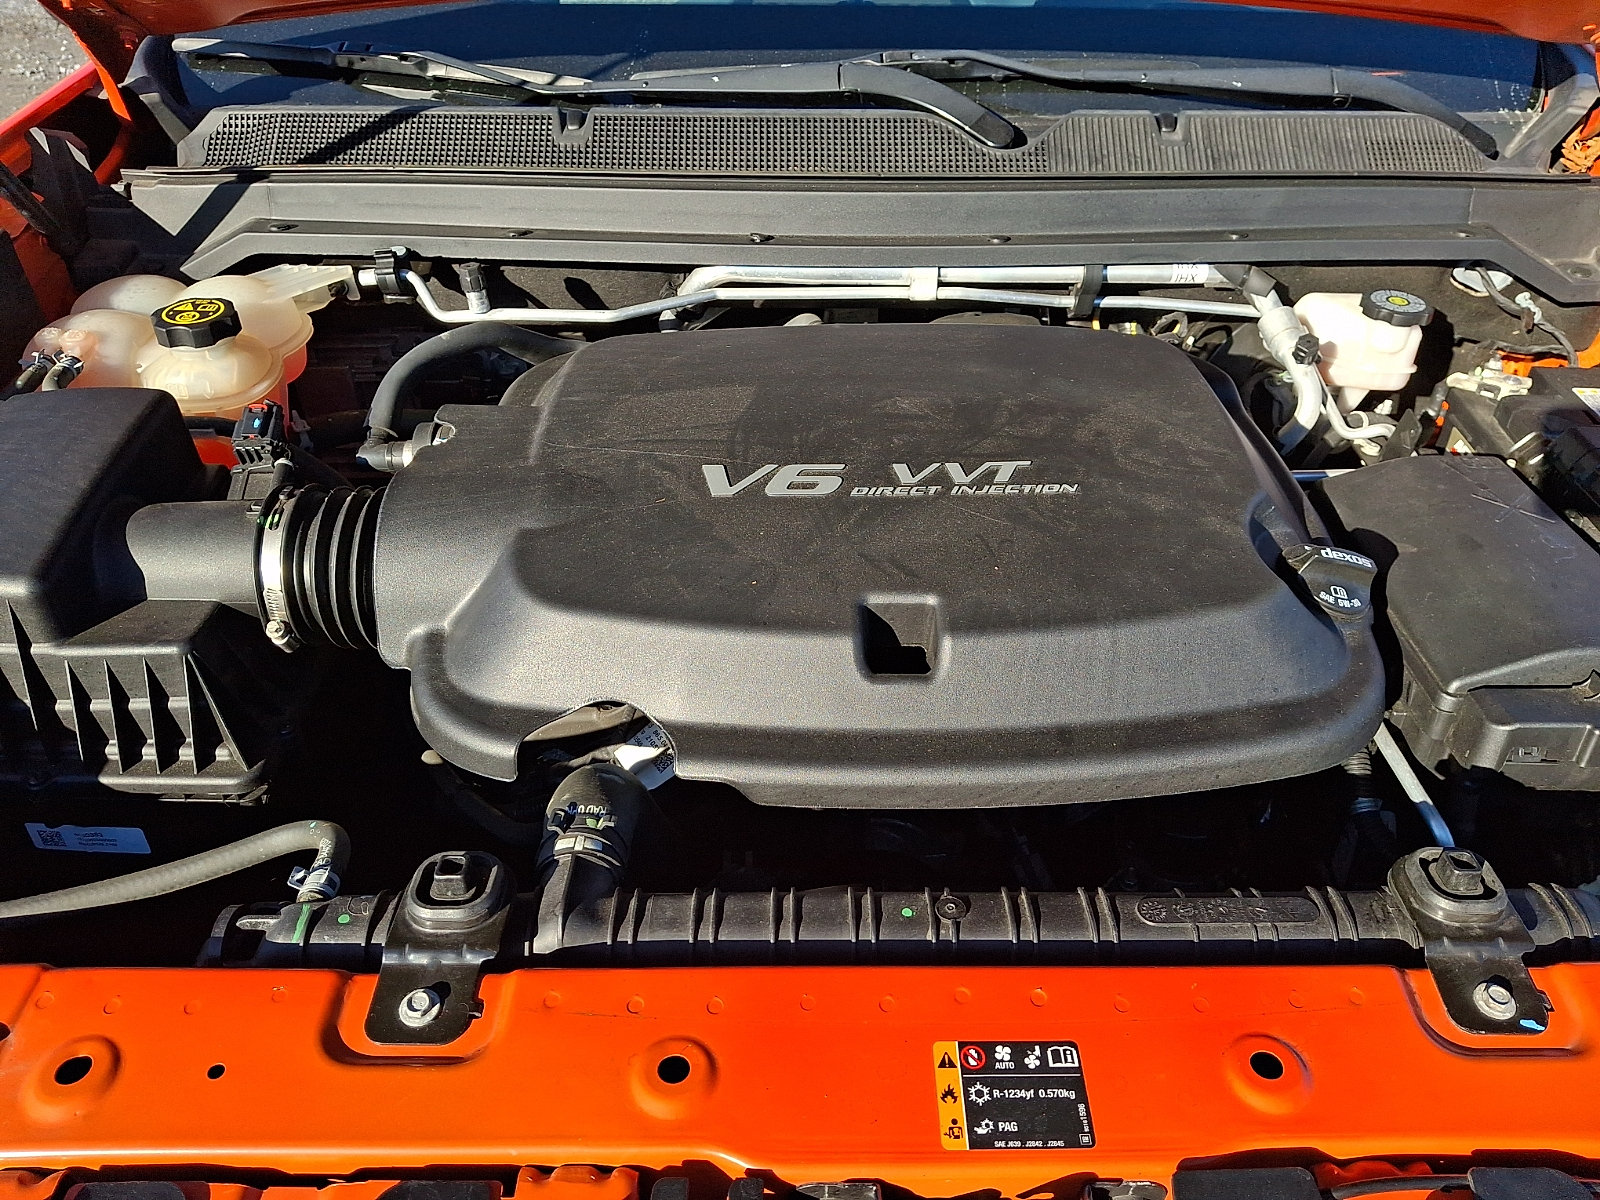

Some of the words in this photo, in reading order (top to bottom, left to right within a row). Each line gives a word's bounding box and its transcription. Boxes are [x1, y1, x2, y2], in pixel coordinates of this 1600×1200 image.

[891, 460, 1033, 485] VVT
[701, 462, 847, 498] V6
[850, 485, 942, 498] DIRECT
[950, 483, 1081, 497] INJECTION
[1320, 548, 1372, 568] dexos
[1319, 591, 1335, 604] SAE
[994, 1061, 1015, 1070] AUTO
[993, 1088, 1035, 1100] R-1234yf
[1038, 1088, 1076, 1100] 0.570kg
[998, 1121, 1019, 1132] PAG
